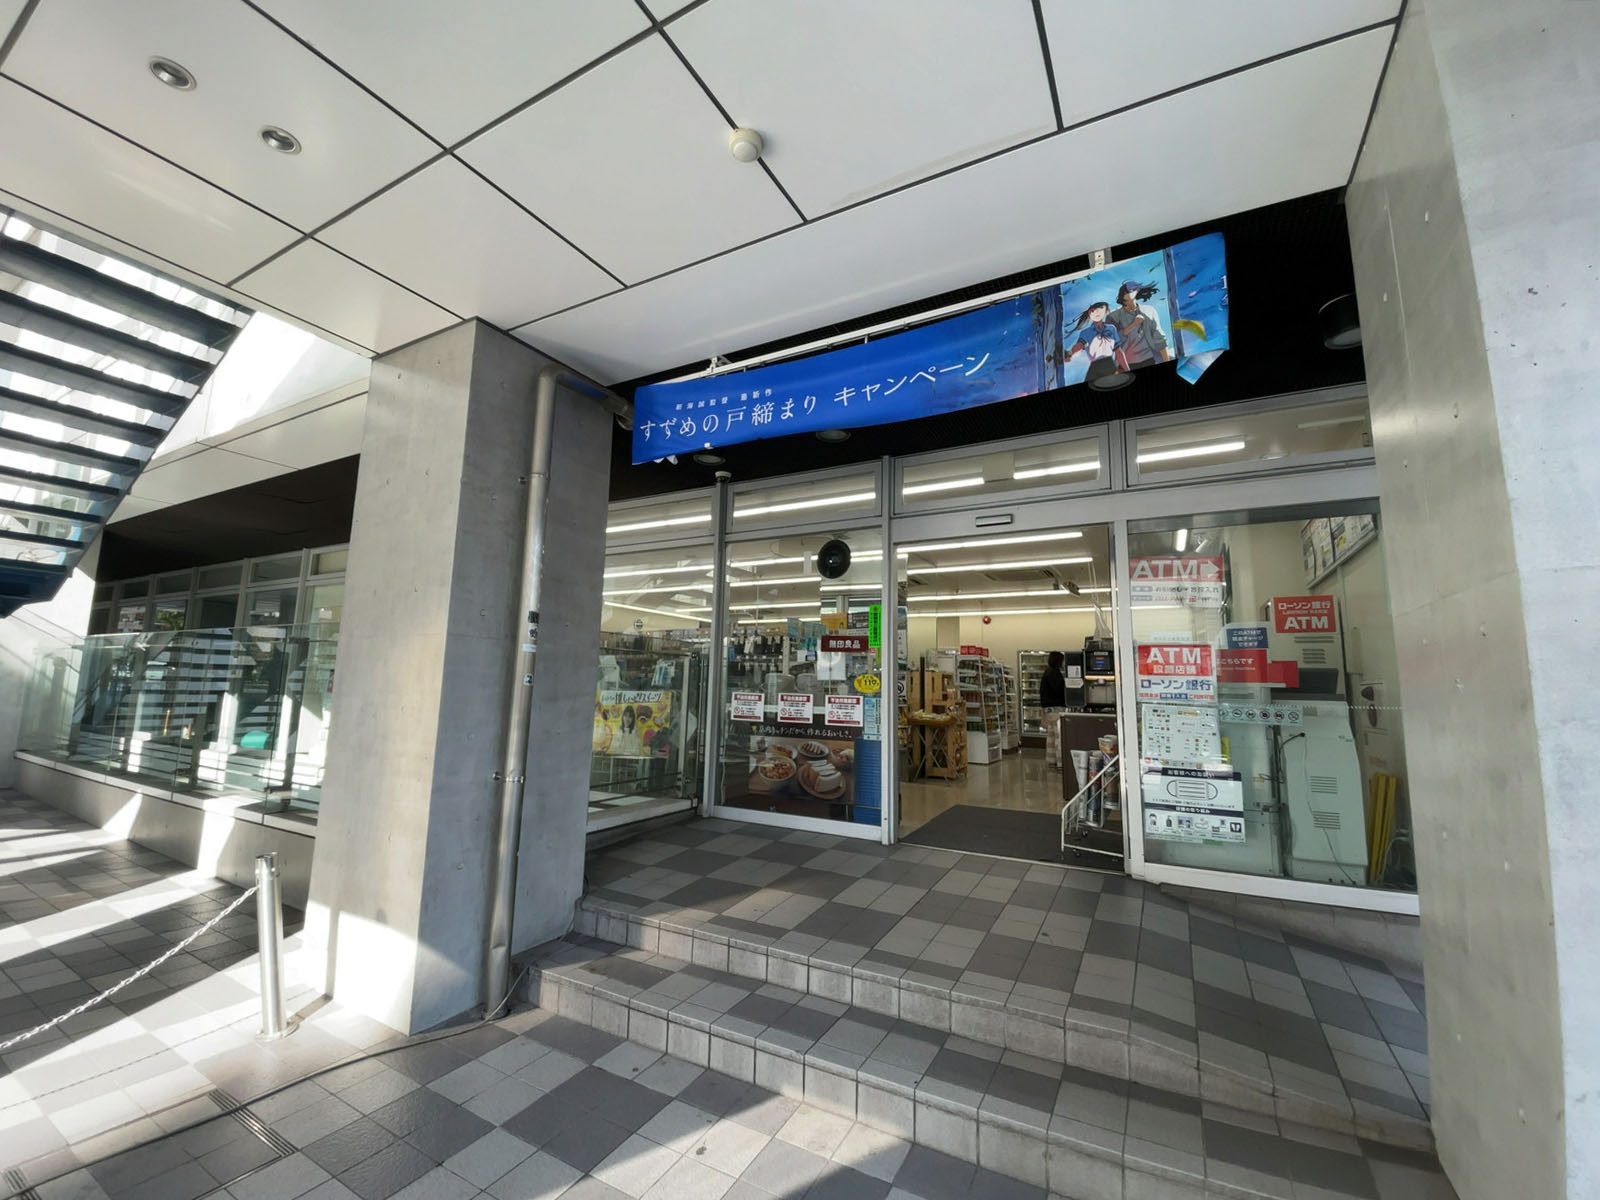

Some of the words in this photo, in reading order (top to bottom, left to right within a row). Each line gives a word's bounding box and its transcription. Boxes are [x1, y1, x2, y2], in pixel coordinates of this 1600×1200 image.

[639, 395, 817, 442] すずめの戸締まり
[833, 352, 990, 406] キャンペーン
[1132, 559, 1198, 579] ATM
[1278, 601, 1331, 610] ローソン銀行
[1284, 616, 1329, 630] ATM
[829, 640, 861, 649] 無印良品
[1146, 648, 1201, 664] ATM
[1141, 679, 1212, 691] ローソン銀行
